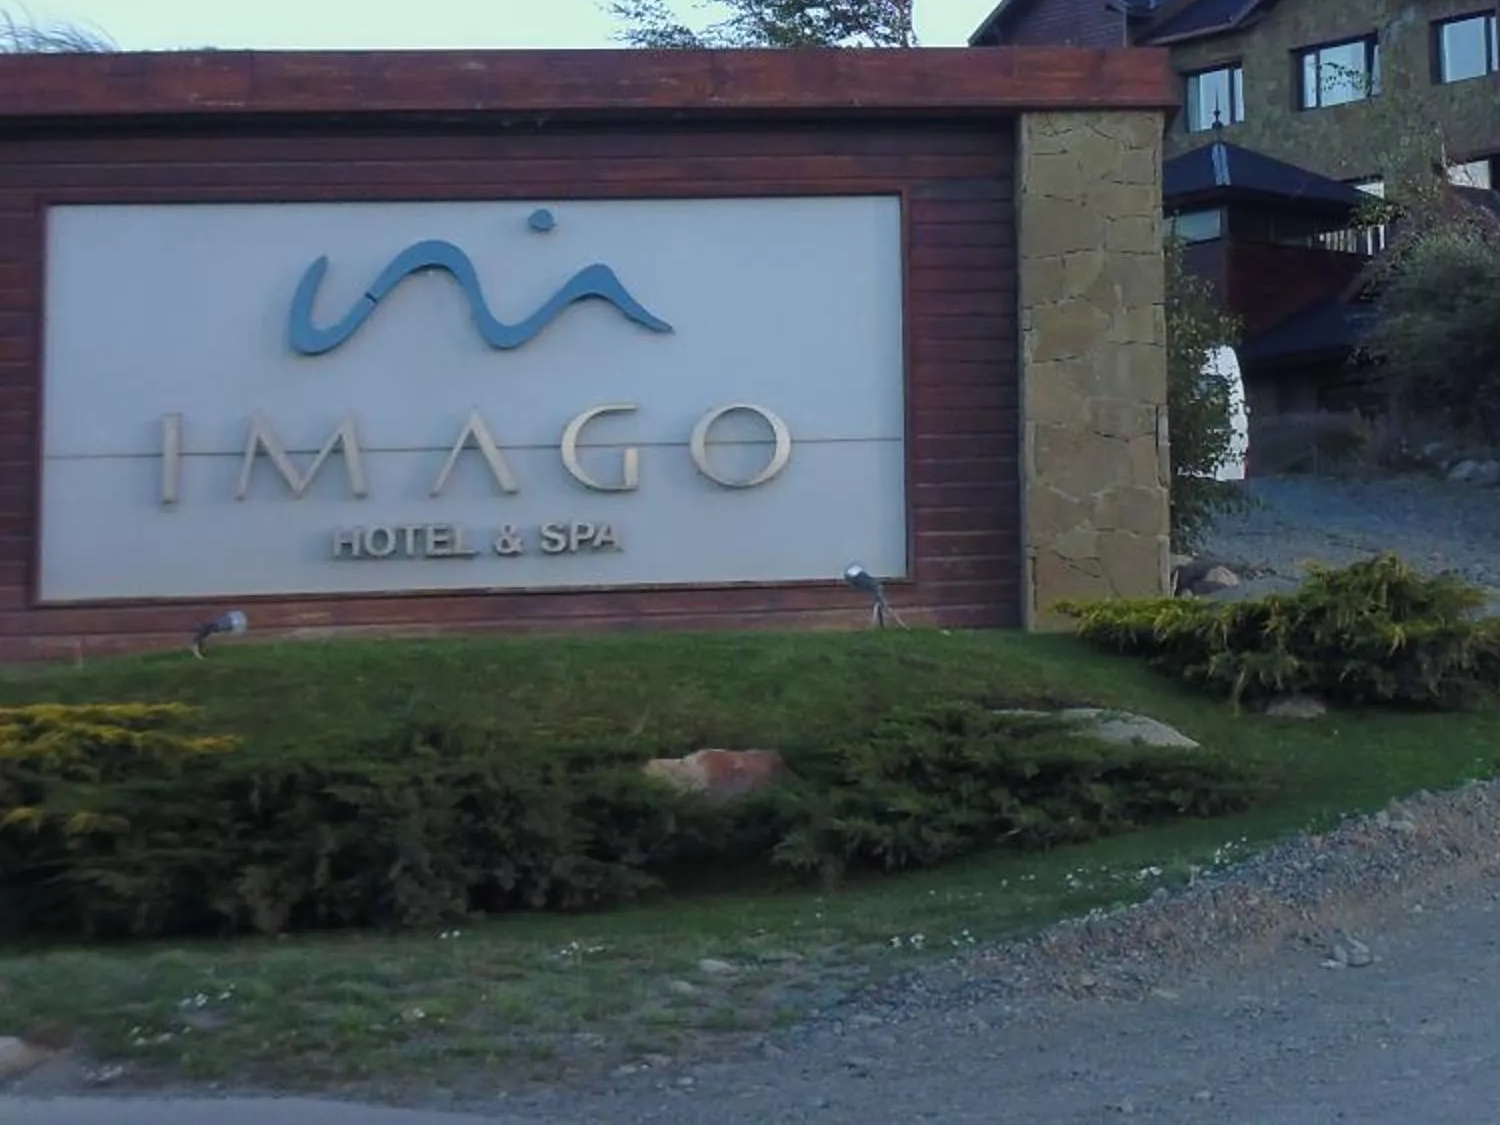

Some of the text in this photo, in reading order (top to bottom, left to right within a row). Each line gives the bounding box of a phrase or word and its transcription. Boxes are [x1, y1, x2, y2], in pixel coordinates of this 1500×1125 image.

[160, 403, 793, 504] IMAGO
[332, 521, 623, 560] HOTEL & SPA
